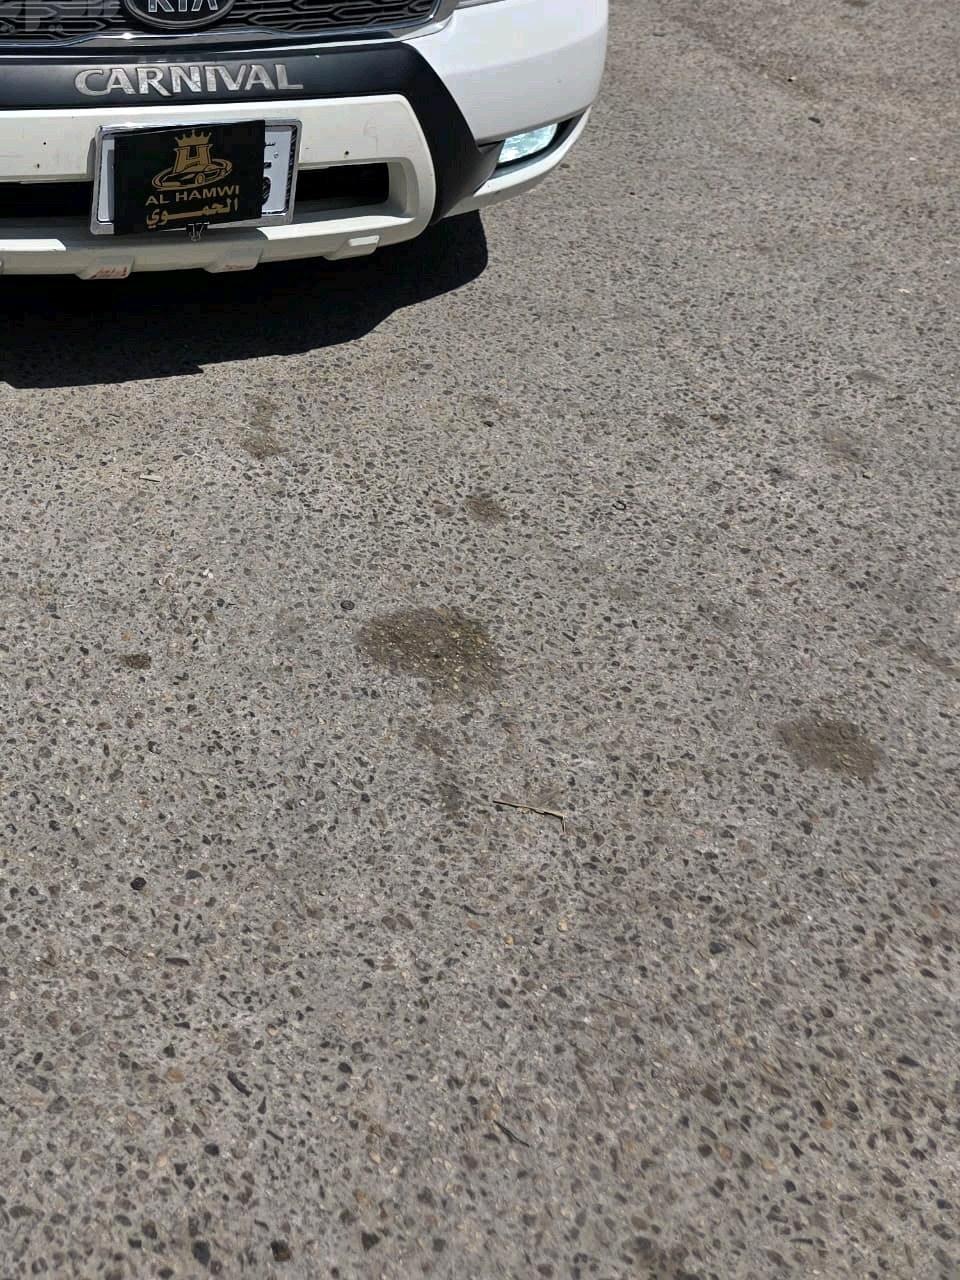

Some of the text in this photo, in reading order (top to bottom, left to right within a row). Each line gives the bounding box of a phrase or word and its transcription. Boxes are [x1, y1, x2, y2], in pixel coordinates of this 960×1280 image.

[74, 63, 305, 98] CARNIVAL
[145, 184, 240, 206] AL HAMWI
[146, 199, 239, 229] الحموي
